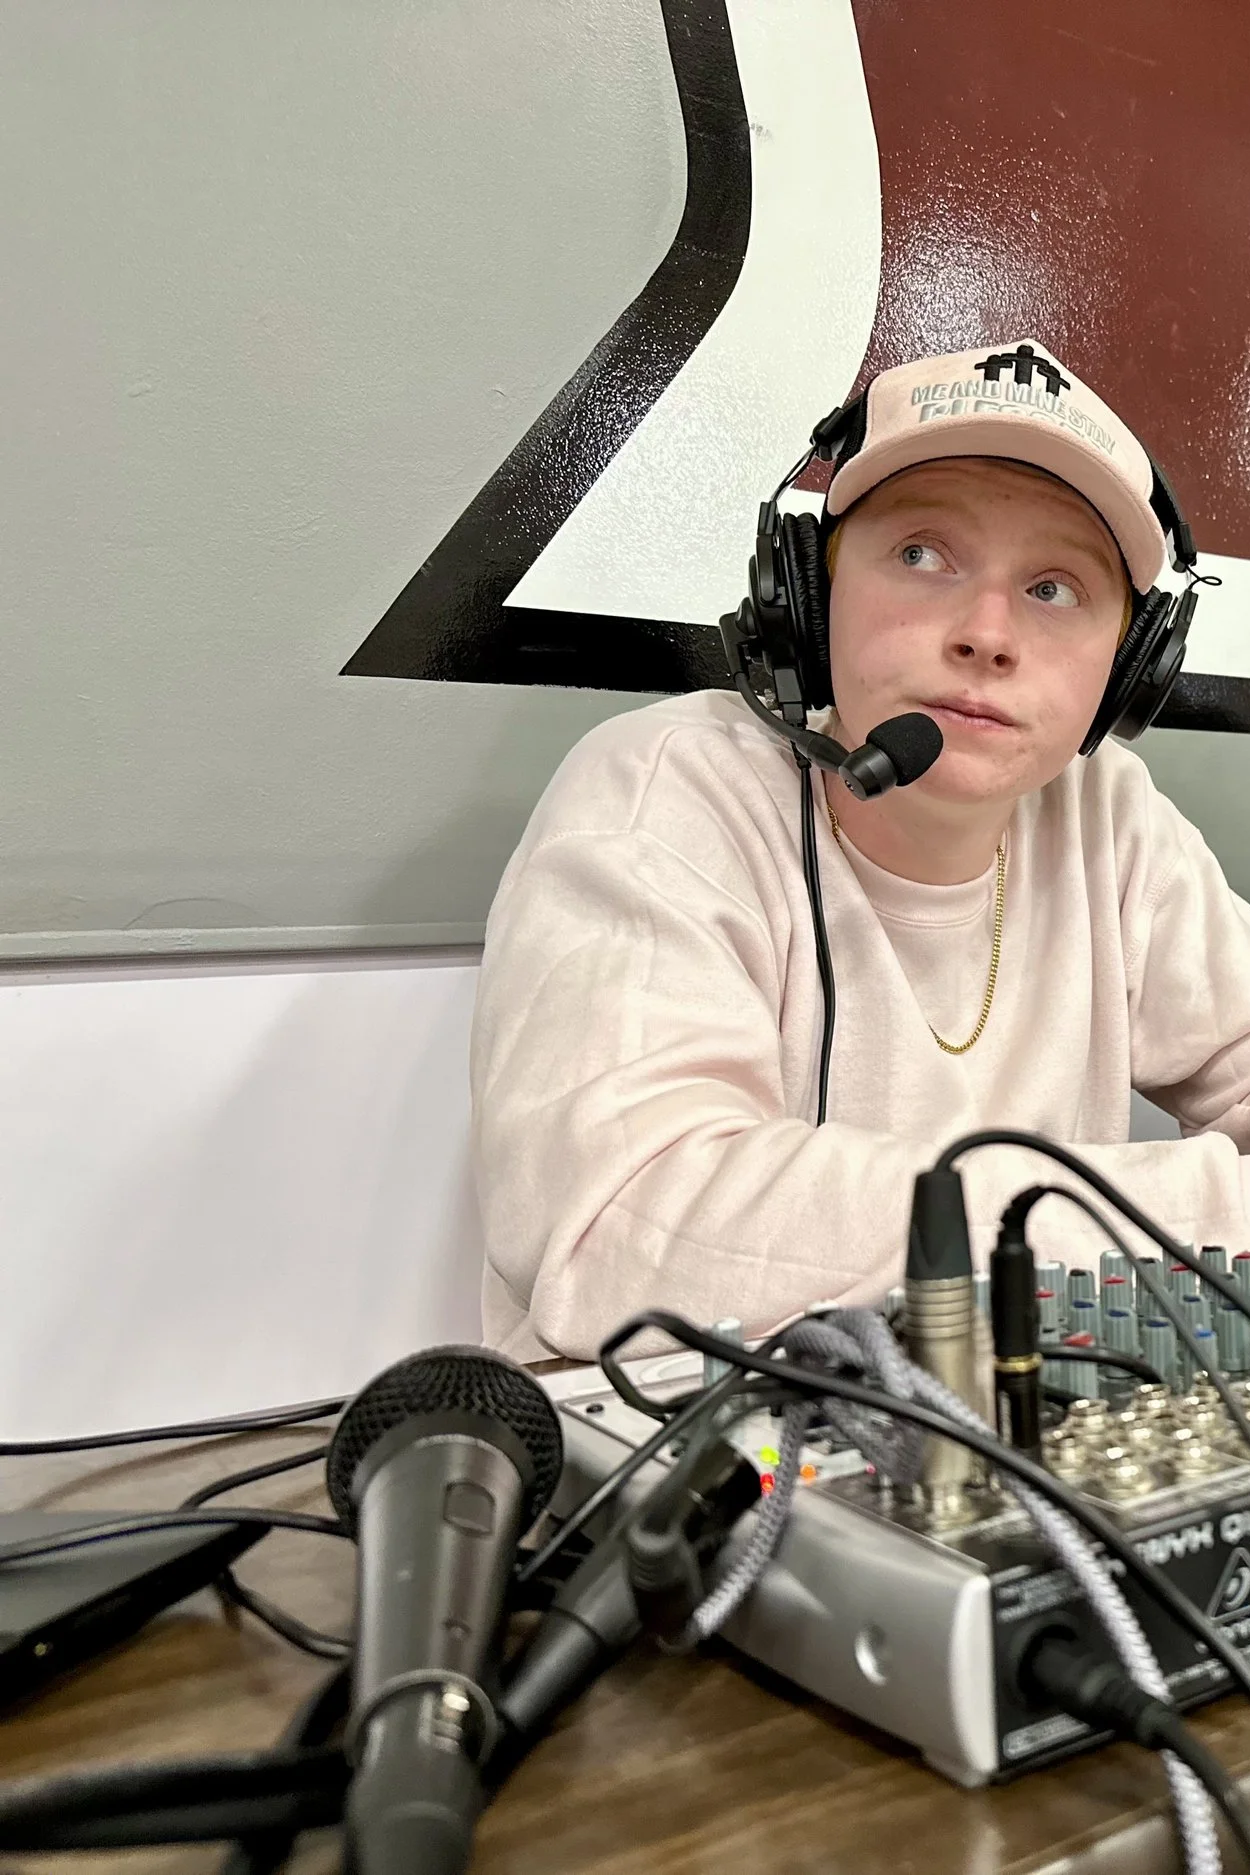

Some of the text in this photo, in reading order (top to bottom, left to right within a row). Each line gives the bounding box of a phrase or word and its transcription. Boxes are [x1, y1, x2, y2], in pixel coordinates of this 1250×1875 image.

[911, 379, 1117, 455] ME AND MINE STAY
